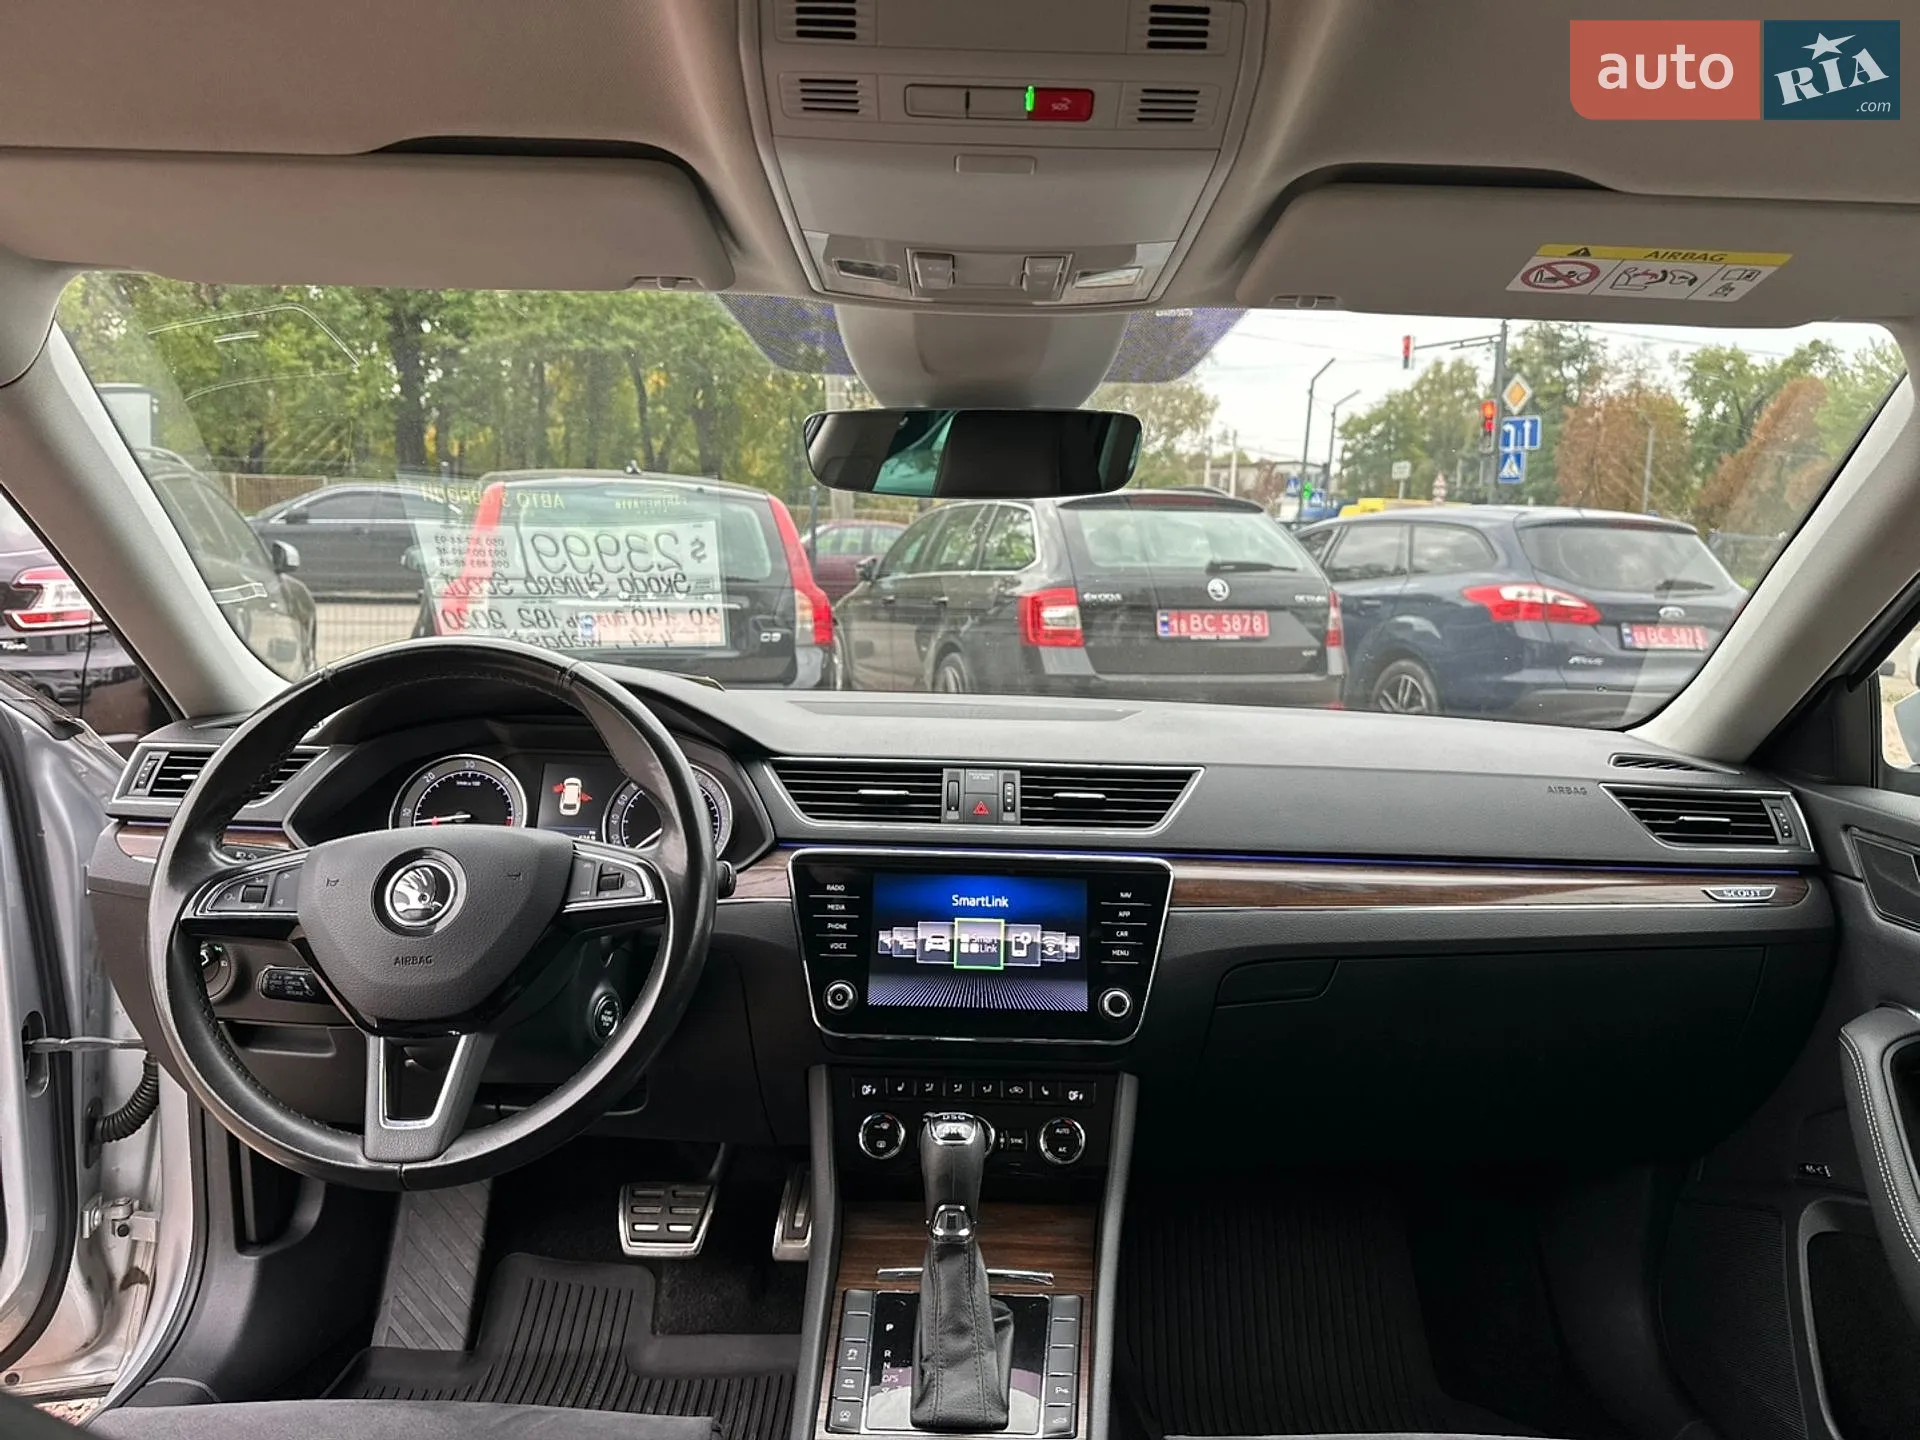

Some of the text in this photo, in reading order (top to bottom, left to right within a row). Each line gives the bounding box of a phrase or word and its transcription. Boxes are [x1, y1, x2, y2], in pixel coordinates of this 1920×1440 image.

[1643, 250, 1728, 262] AIRBAG
[1222, 614, 1265, 633] 5878
[1546, 785, 1587, 796] AIRBAG
[826, 884, 845, 892] RADIO
[1723, 889, 1761, 898] SCOUT
[952, 894, 1009, 908] SmartLink
[827, 922, 848, 930] PHONE
[970, 934, 998, 944] Smart
[829, 942, 847, 950] VOICE
[980, 943, 998, 953] Link
[1111, 949, 1130, 957] MENU
[393, 955, 433, 967] AIRBAG
